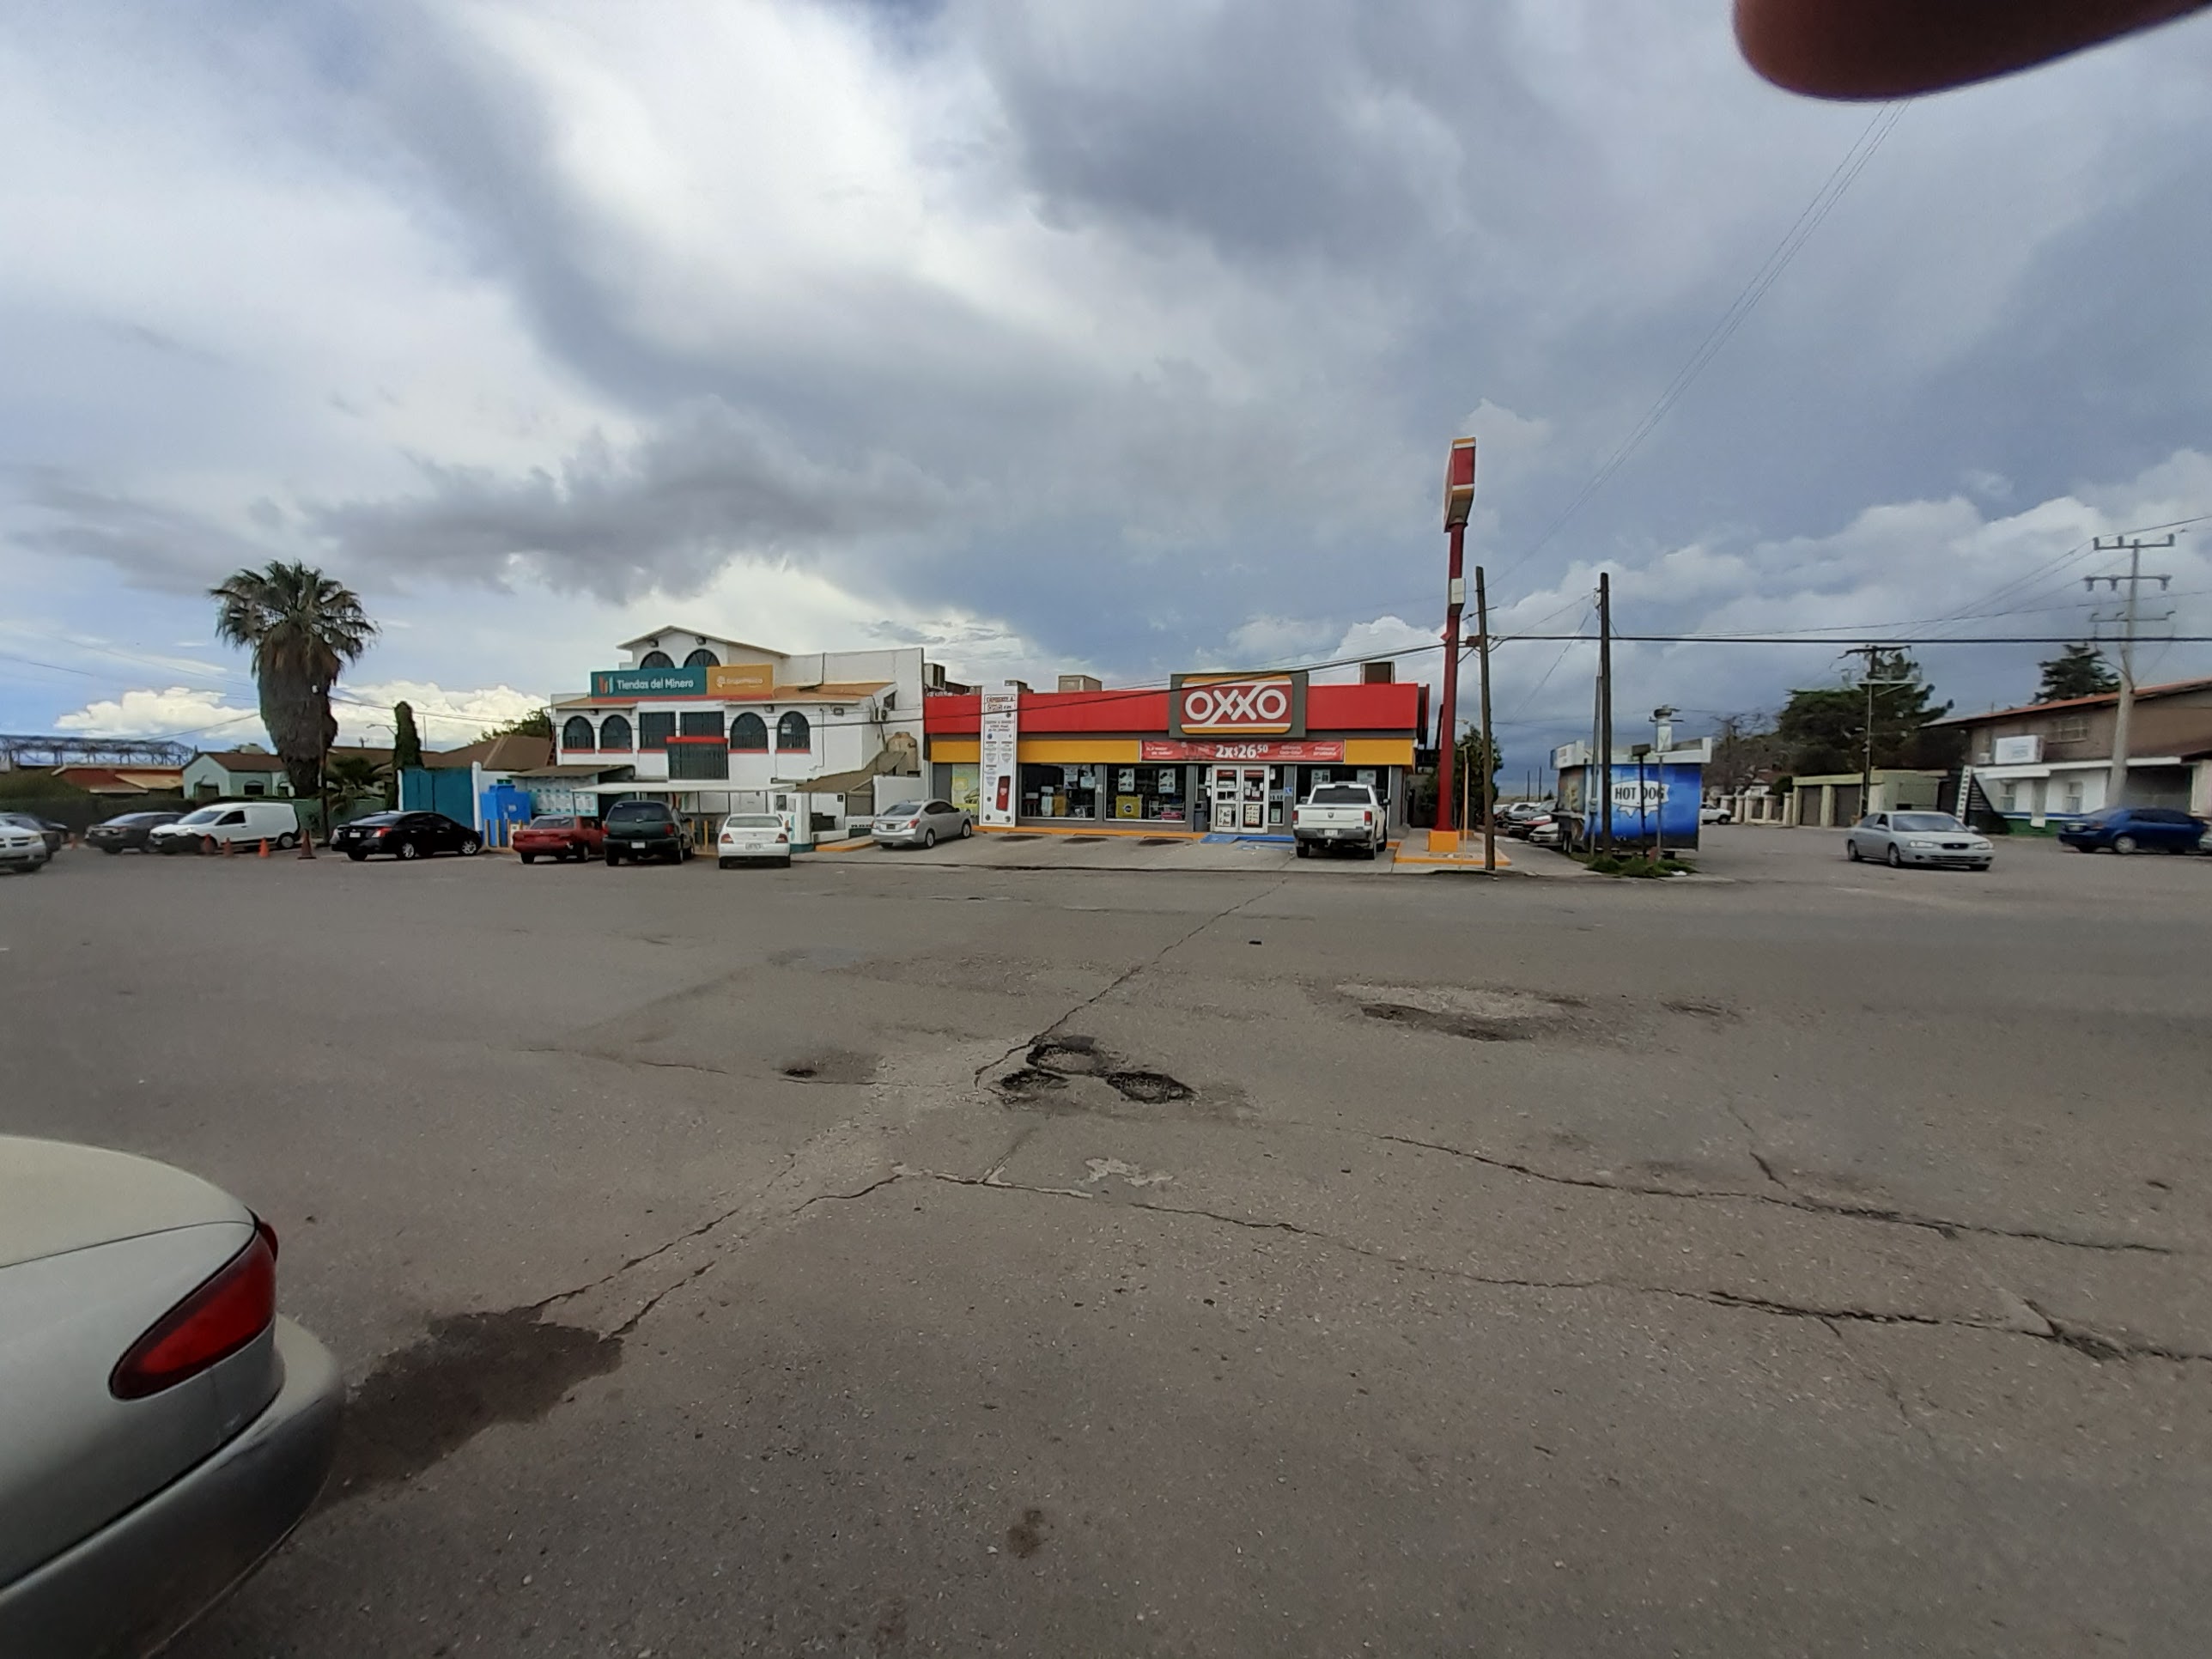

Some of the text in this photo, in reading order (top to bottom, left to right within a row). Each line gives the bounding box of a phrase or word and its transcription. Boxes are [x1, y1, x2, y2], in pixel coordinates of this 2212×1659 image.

[617, 677, 694, 690] Tiendas del Minero
[1185, 686, 1286, 726] OXXO
[1614, 787, 1664, 799] HOT DOG
